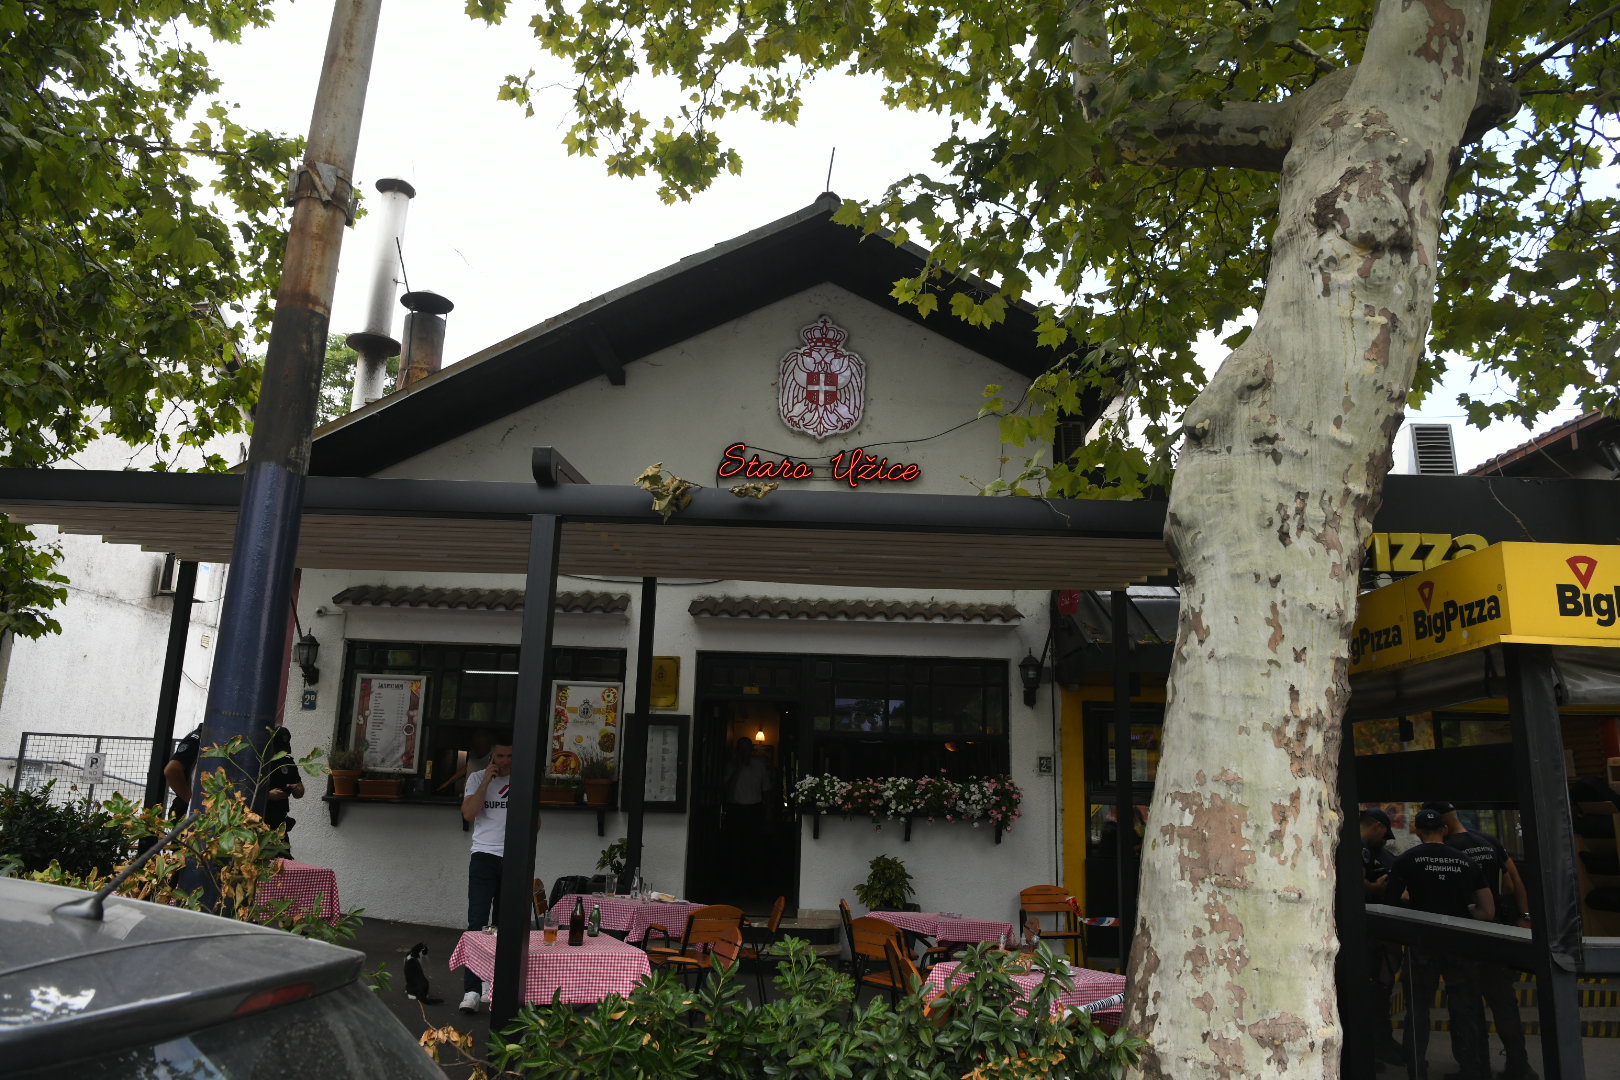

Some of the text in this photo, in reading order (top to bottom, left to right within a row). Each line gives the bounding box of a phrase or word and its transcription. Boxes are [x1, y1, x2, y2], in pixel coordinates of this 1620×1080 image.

[718, 442, 921, 488] Staro Užice
[1413, 594, 1502, 643] BigPizza
[1414, 857, 1469, 867] ИНТЕРВЕНТНА
[1424, 864, 1462, 873] ЈЕДИНИЦА
